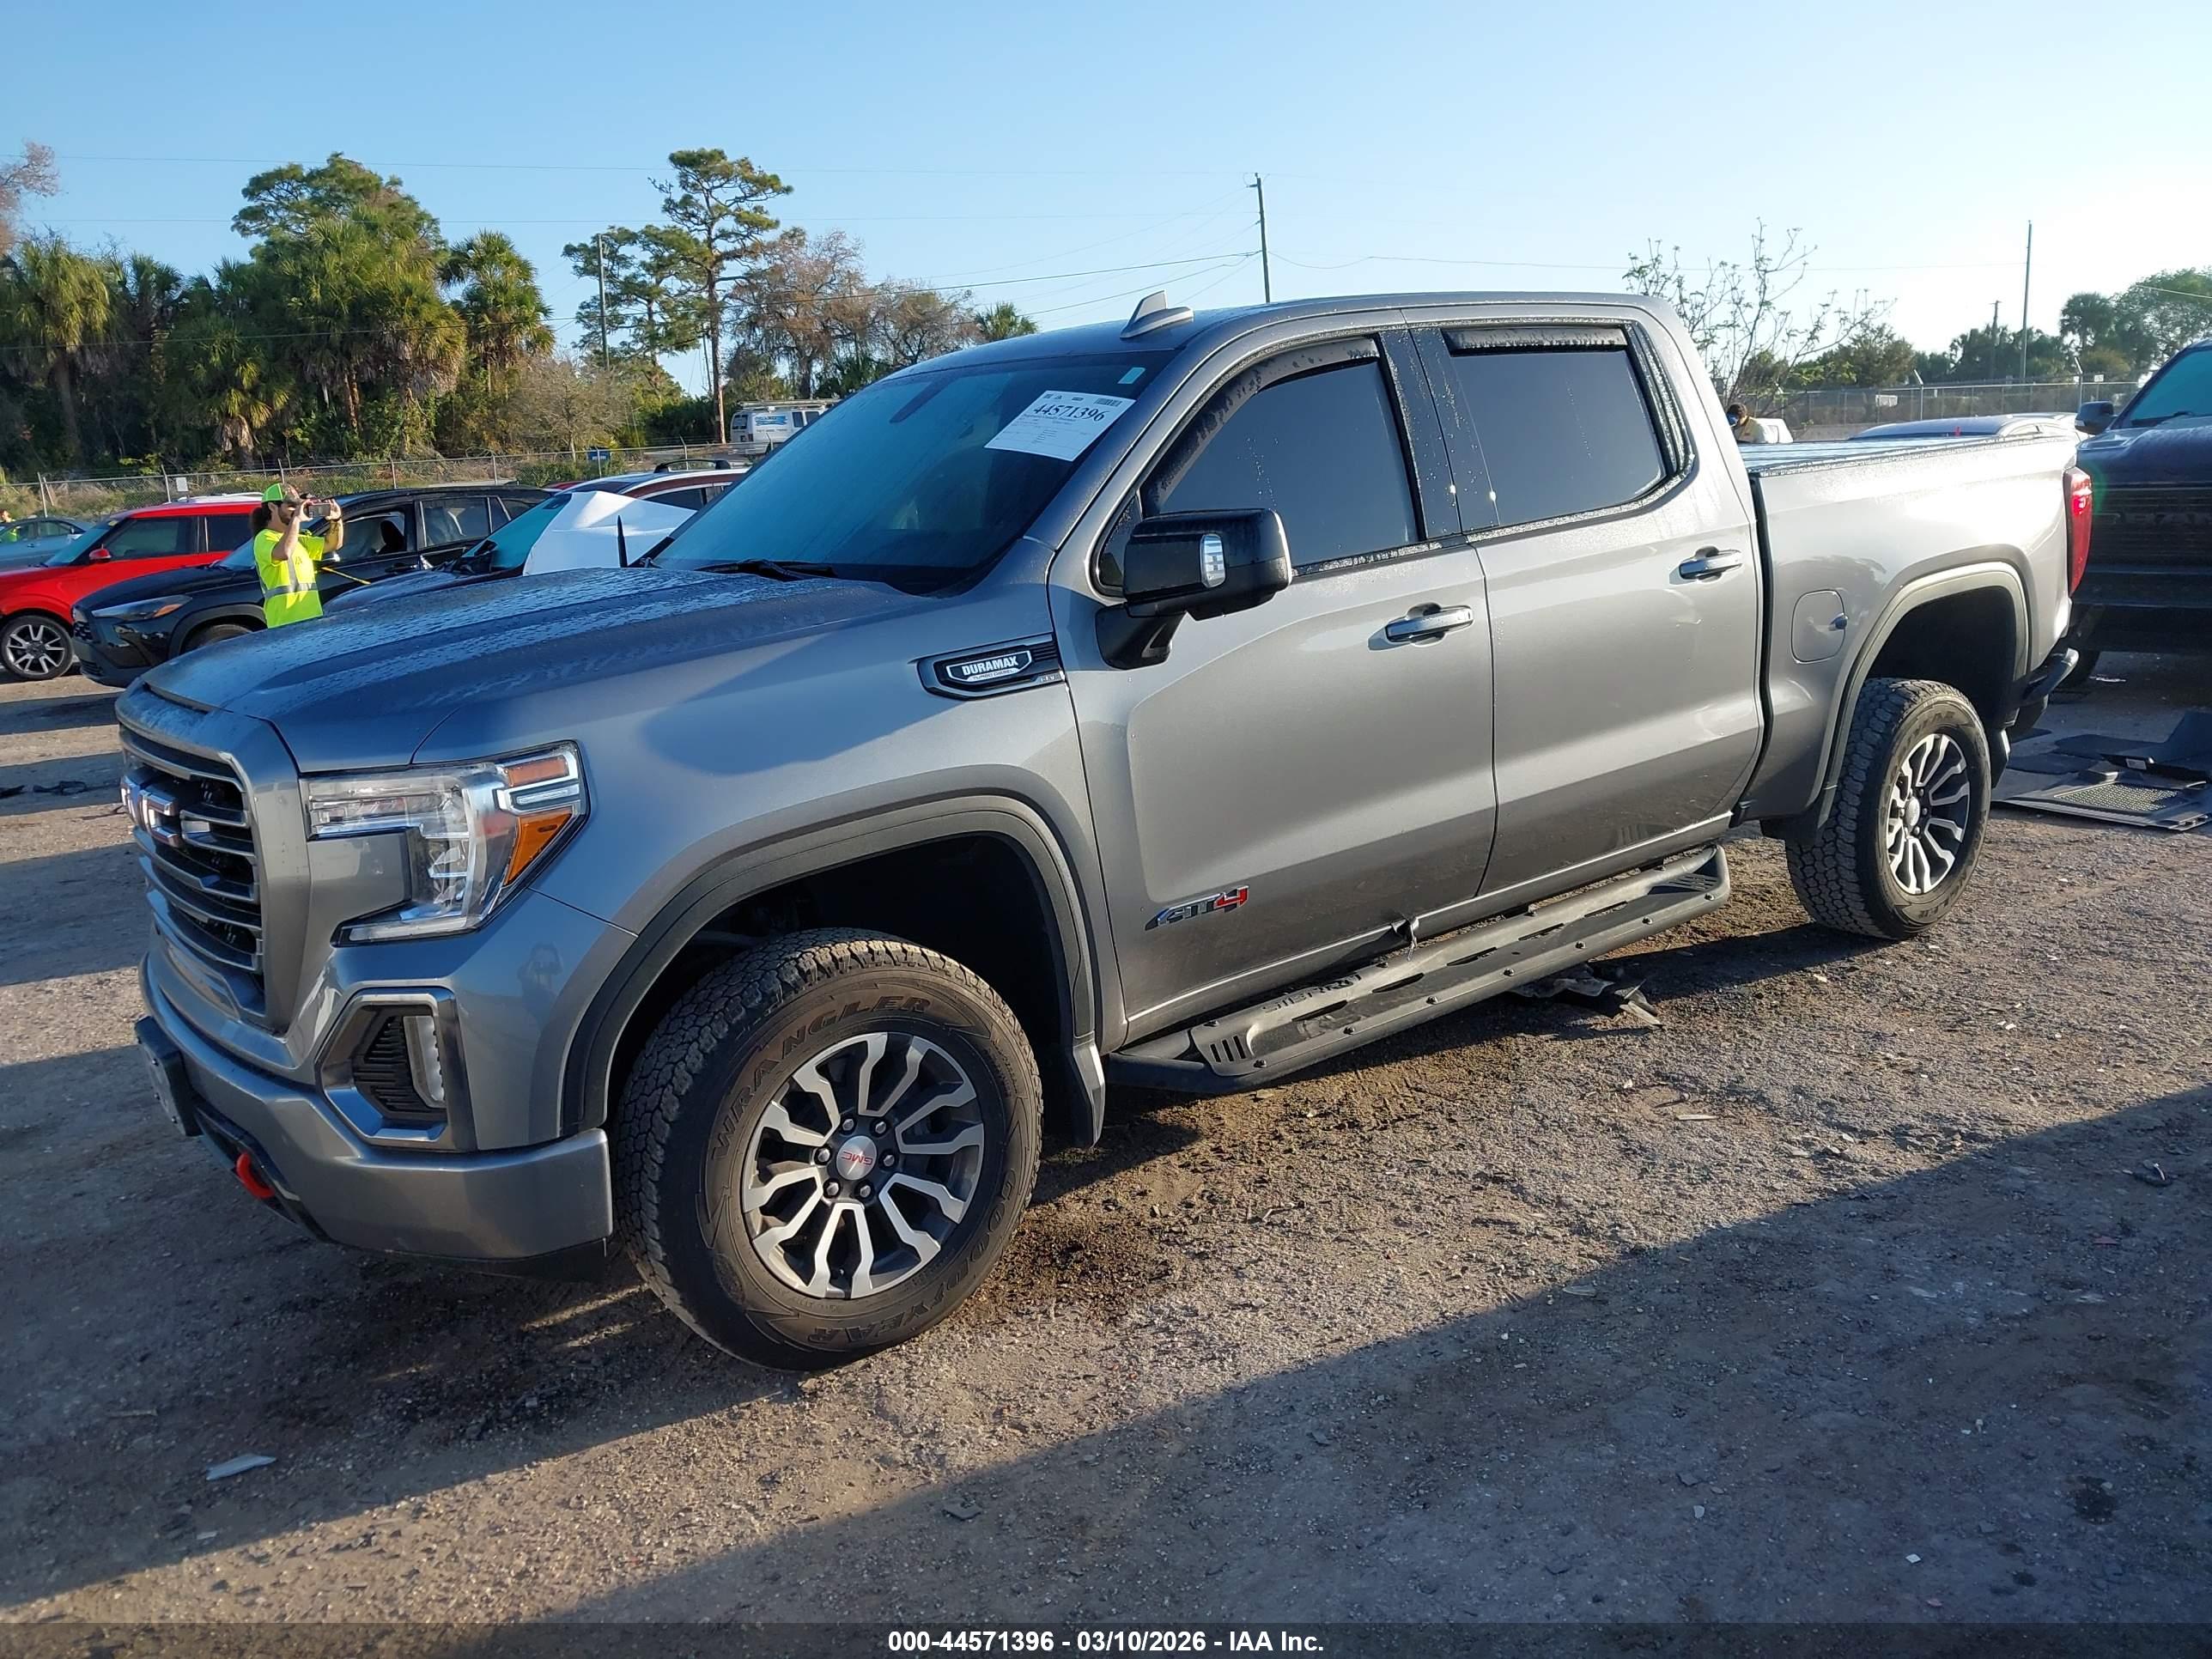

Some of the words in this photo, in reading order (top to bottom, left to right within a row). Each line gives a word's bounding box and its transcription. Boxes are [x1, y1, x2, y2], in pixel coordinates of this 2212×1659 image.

[1033, 403, 1109, 422] 44571396
[962, 656, 1018, 676] DURAMAX
[1145, 885, 1249, 931] AT4
[710, 994, 933, 1161] WRANGLER
[841, 1151, 874, 1166] GMC
[807, 1169, 1017, 1344] GOODYEAR
